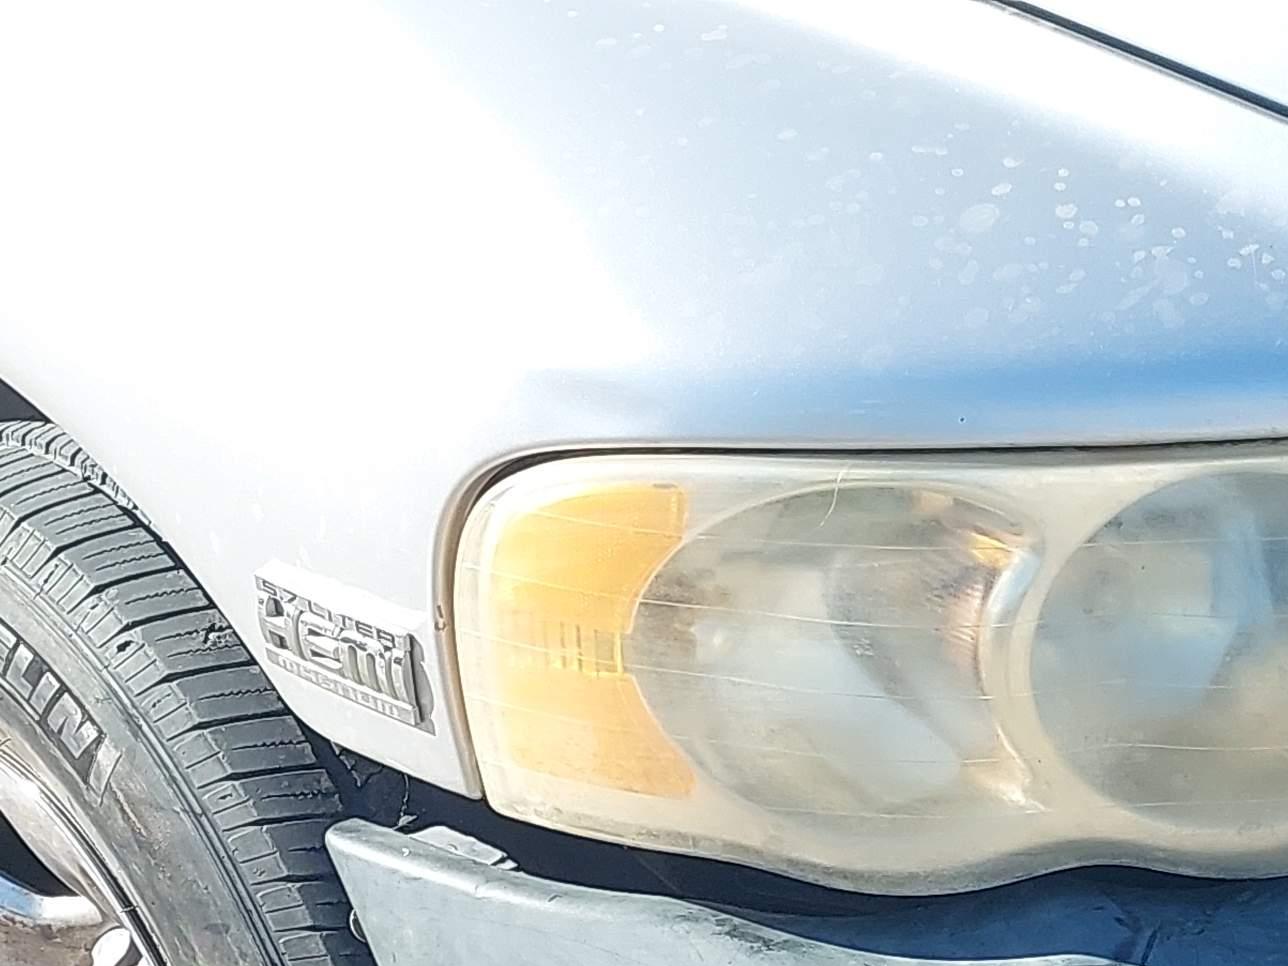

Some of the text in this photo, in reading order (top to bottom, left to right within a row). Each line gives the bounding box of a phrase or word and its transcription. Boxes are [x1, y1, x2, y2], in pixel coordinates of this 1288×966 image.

[257, 595, 411, 706] HEMI
[262, 580, 397, 650] 5.7 LITER
